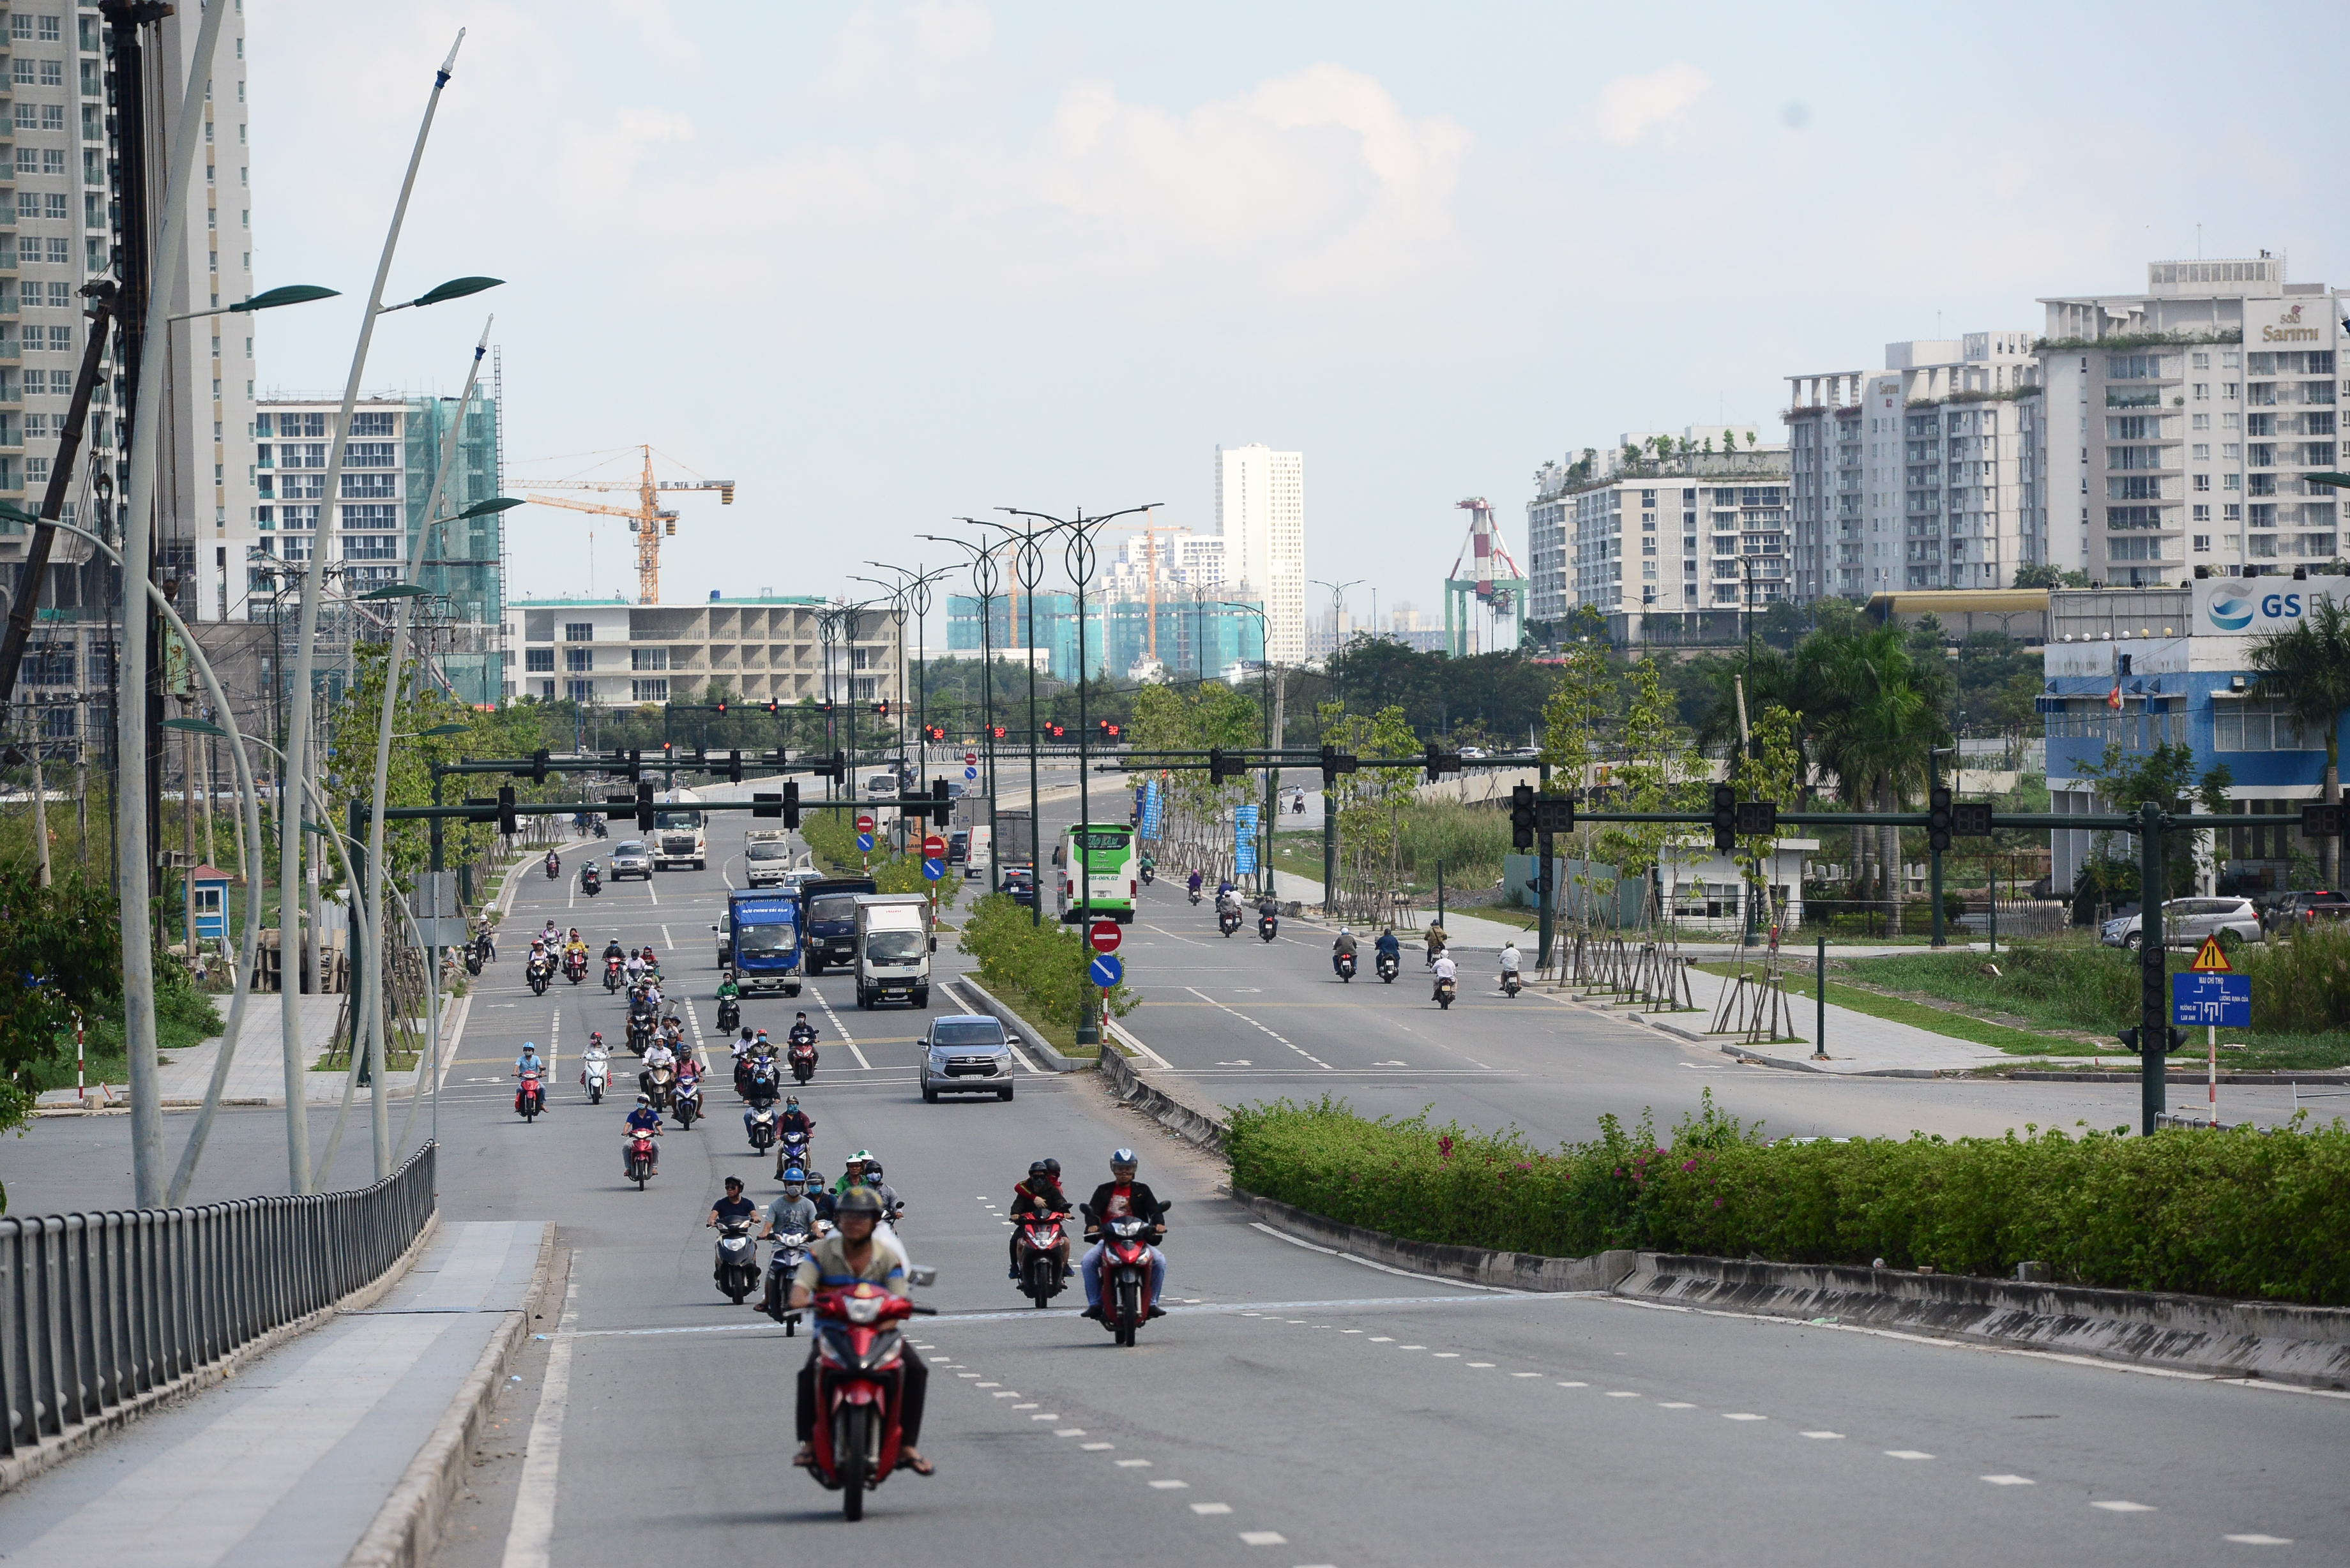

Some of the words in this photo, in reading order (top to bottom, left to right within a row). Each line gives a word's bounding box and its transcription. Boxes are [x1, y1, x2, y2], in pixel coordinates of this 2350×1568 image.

[2261, 594, 2301, 618] GS
[934, 728, 944, 739] 32
[994, 728, 1005, 737] 32
[1053, 727, 1064, 736] 32
[1109, 726, 1119, 735] 32
